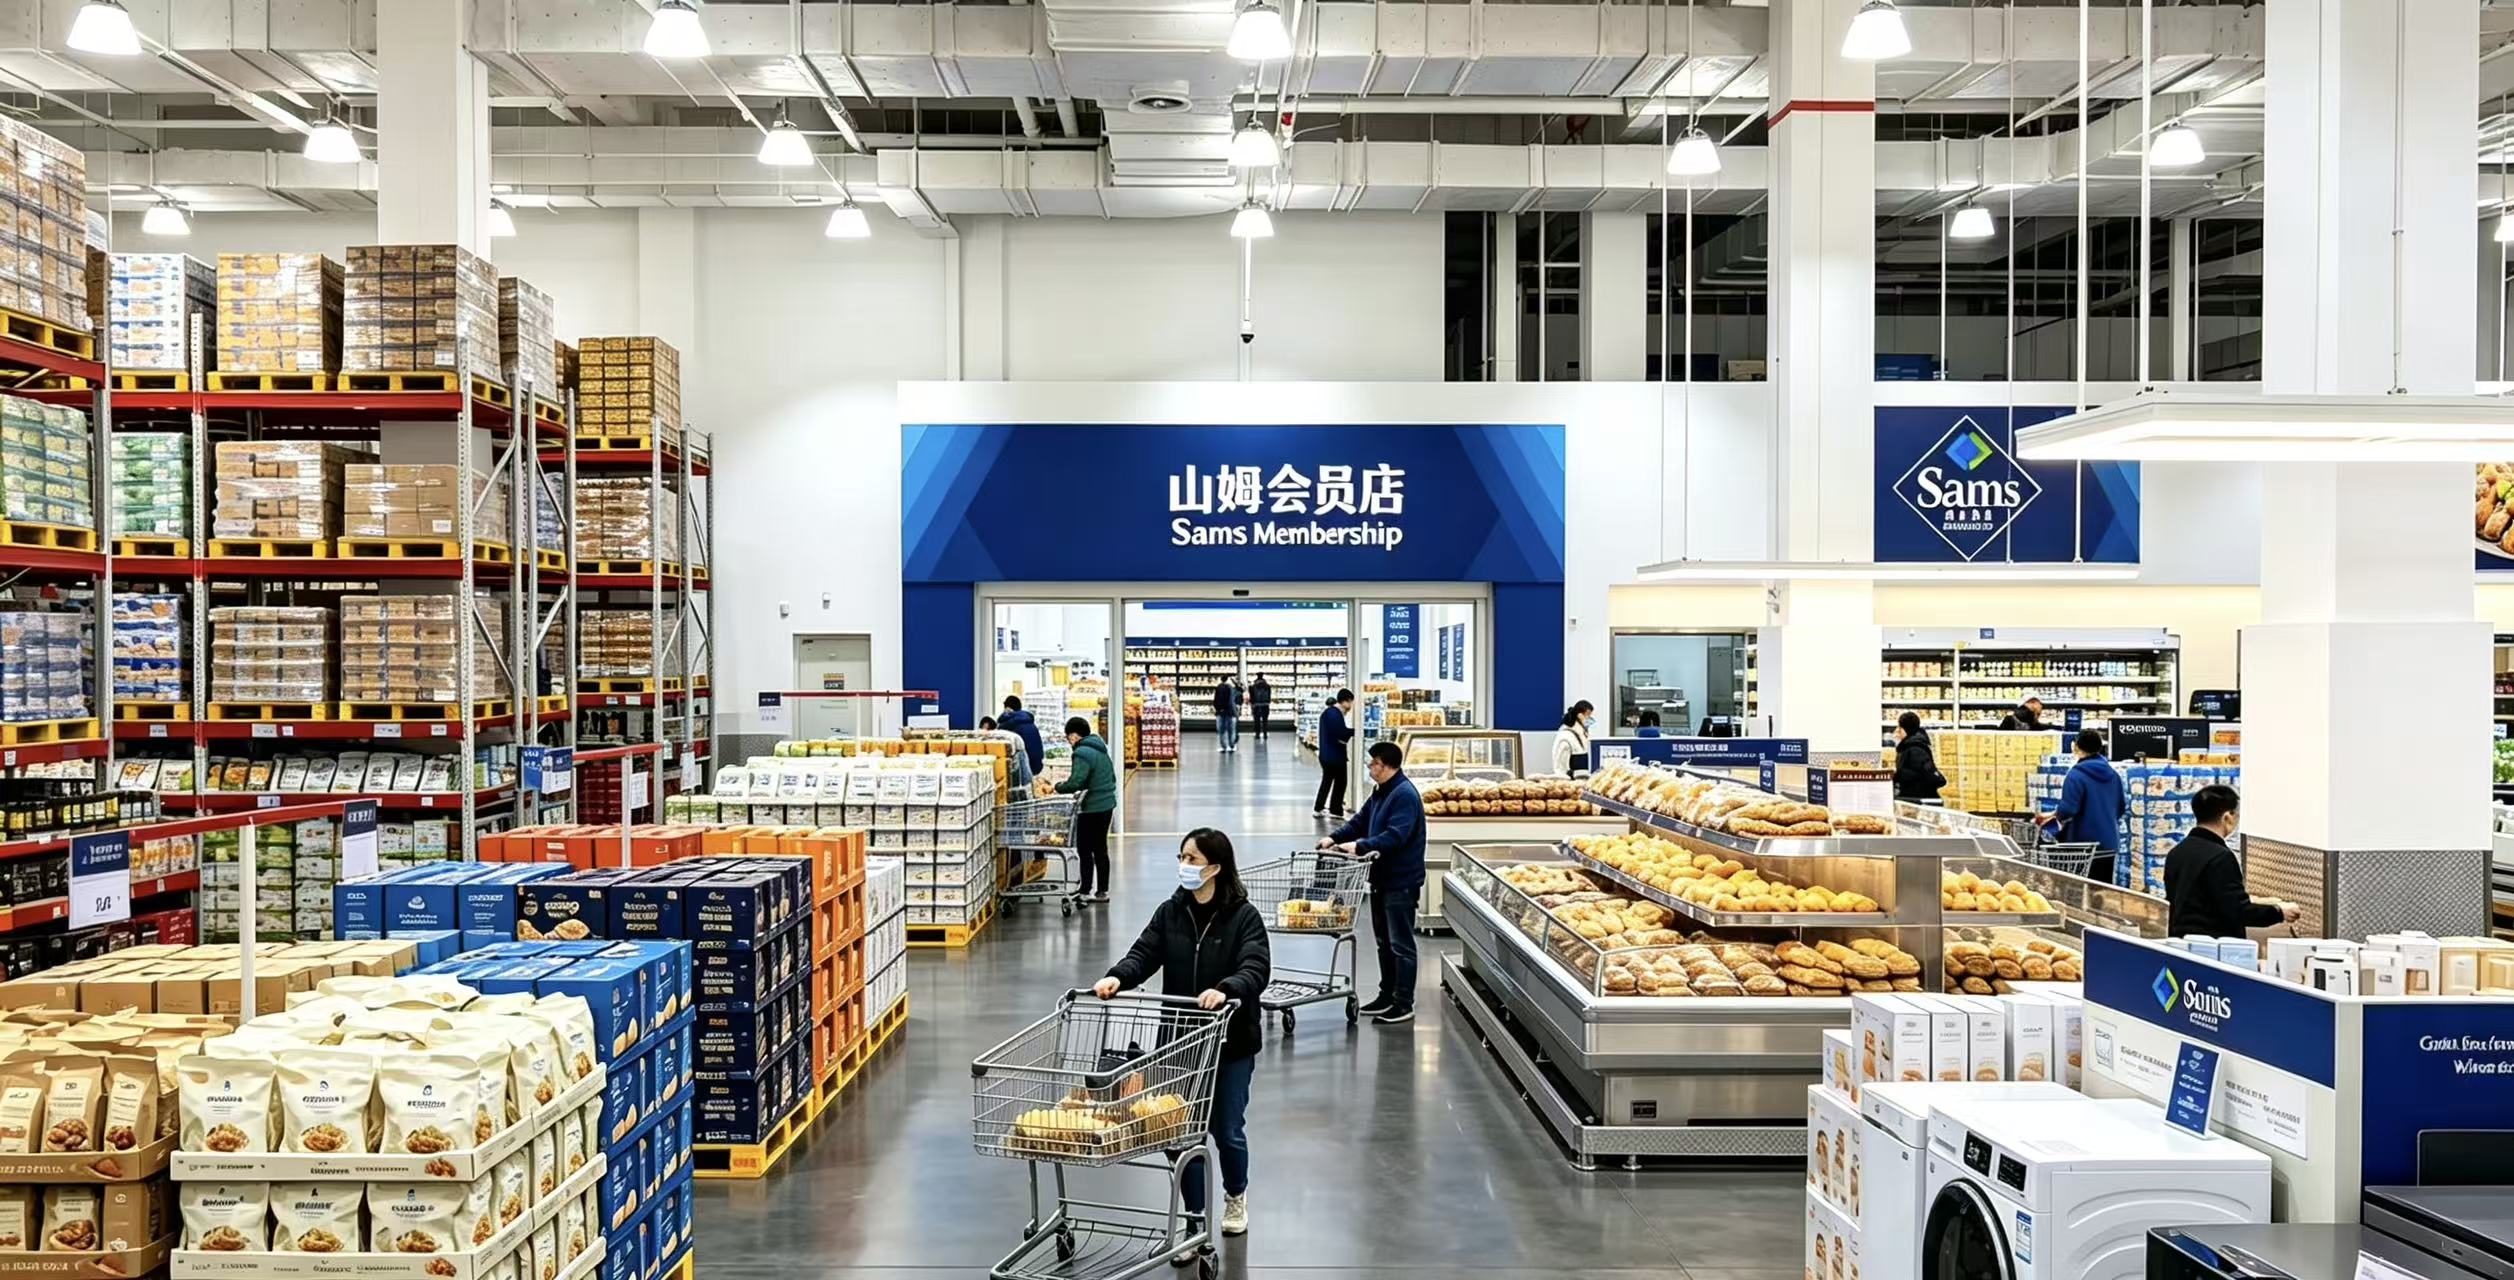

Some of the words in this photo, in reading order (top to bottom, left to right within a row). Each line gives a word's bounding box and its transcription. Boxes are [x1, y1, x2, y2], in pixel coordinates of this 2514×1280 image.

[1169, 463, 1405, 515] 山姆会员店
[1917, 466, 2021, 508] Sams
[1171, 518, 1248, 545] Sams
[1253, 521, 1403, 551] Membership
